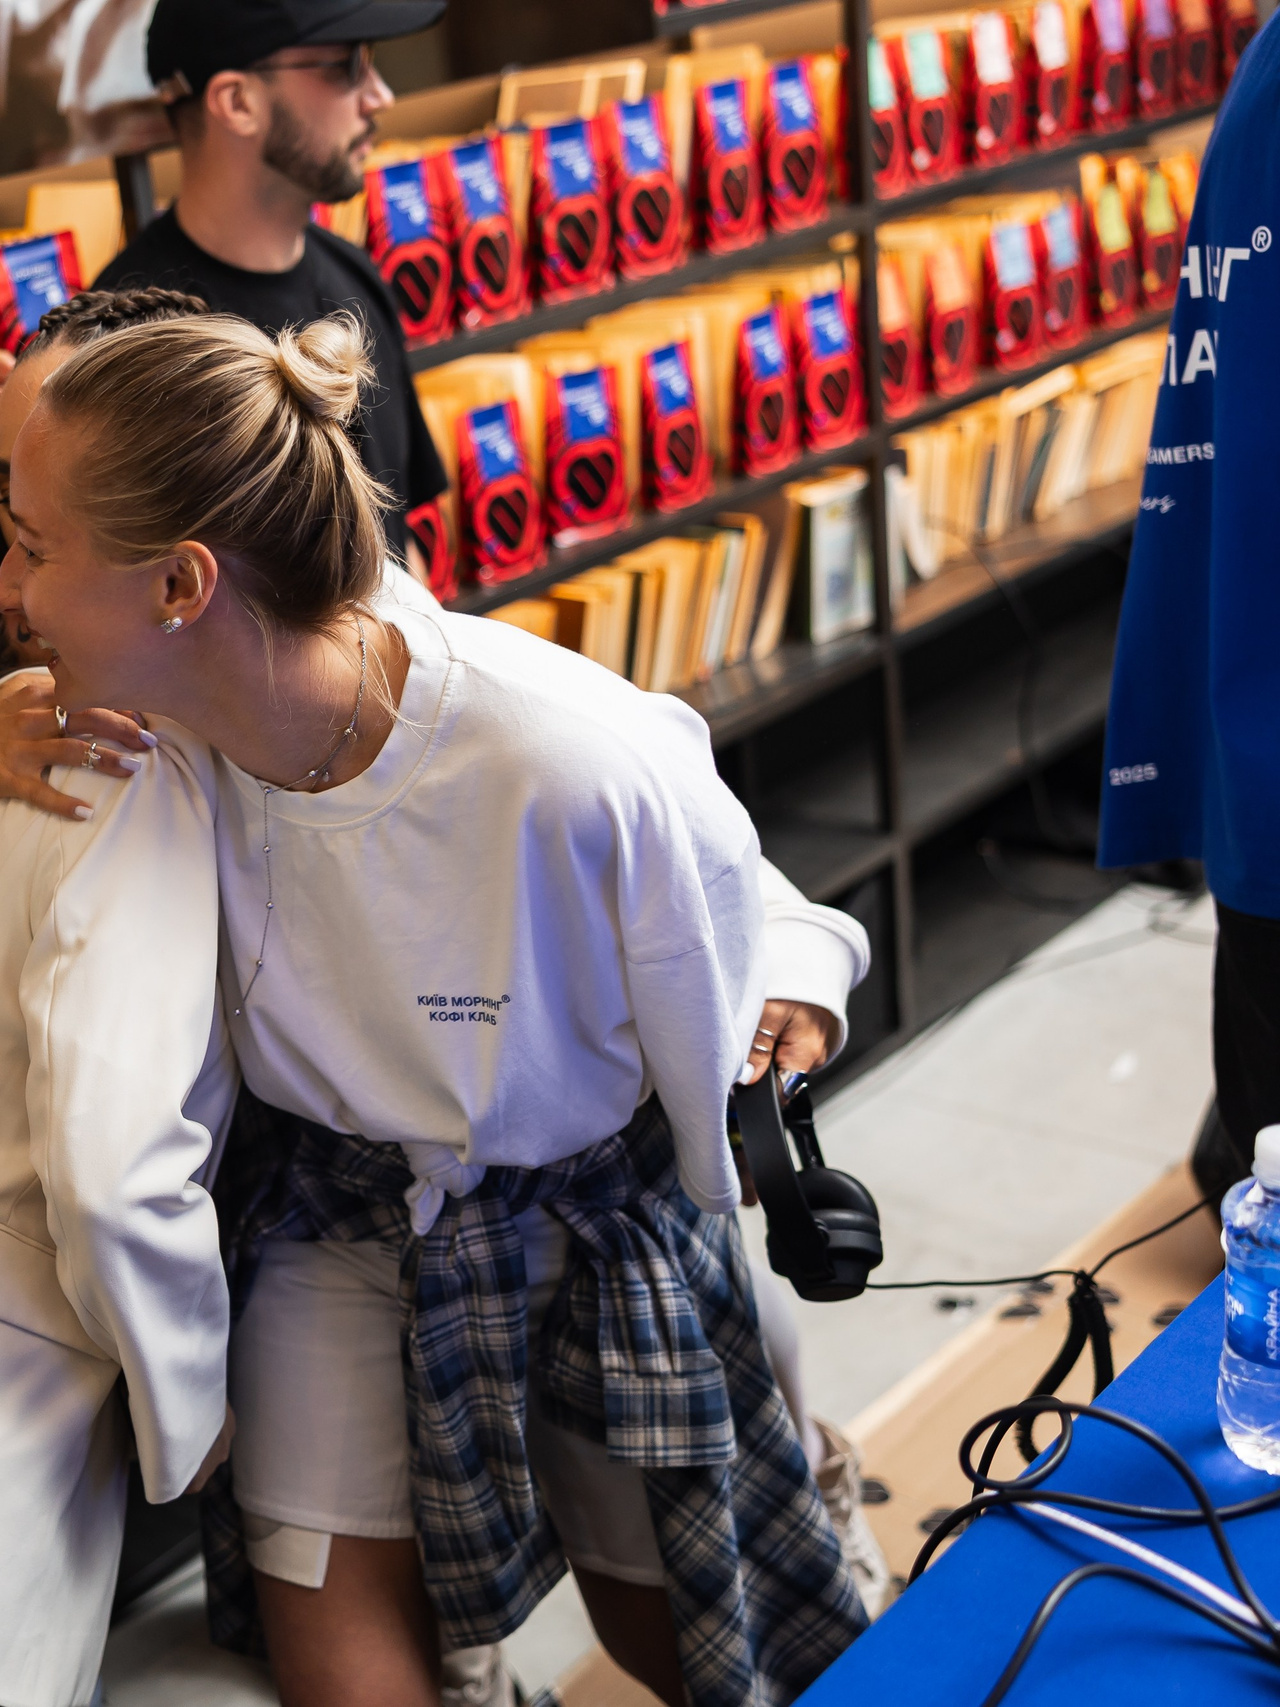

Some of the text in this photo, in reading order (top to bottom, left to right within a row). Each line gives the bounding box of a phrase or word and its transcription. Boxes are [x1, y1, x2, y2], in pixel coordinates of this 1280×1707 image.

[1109, 763, 1158, 787] 2025
[417, 994, 448, 1007] КИЇВ
[429, 1011, 497, 1026] КОФІ КЛАБ
